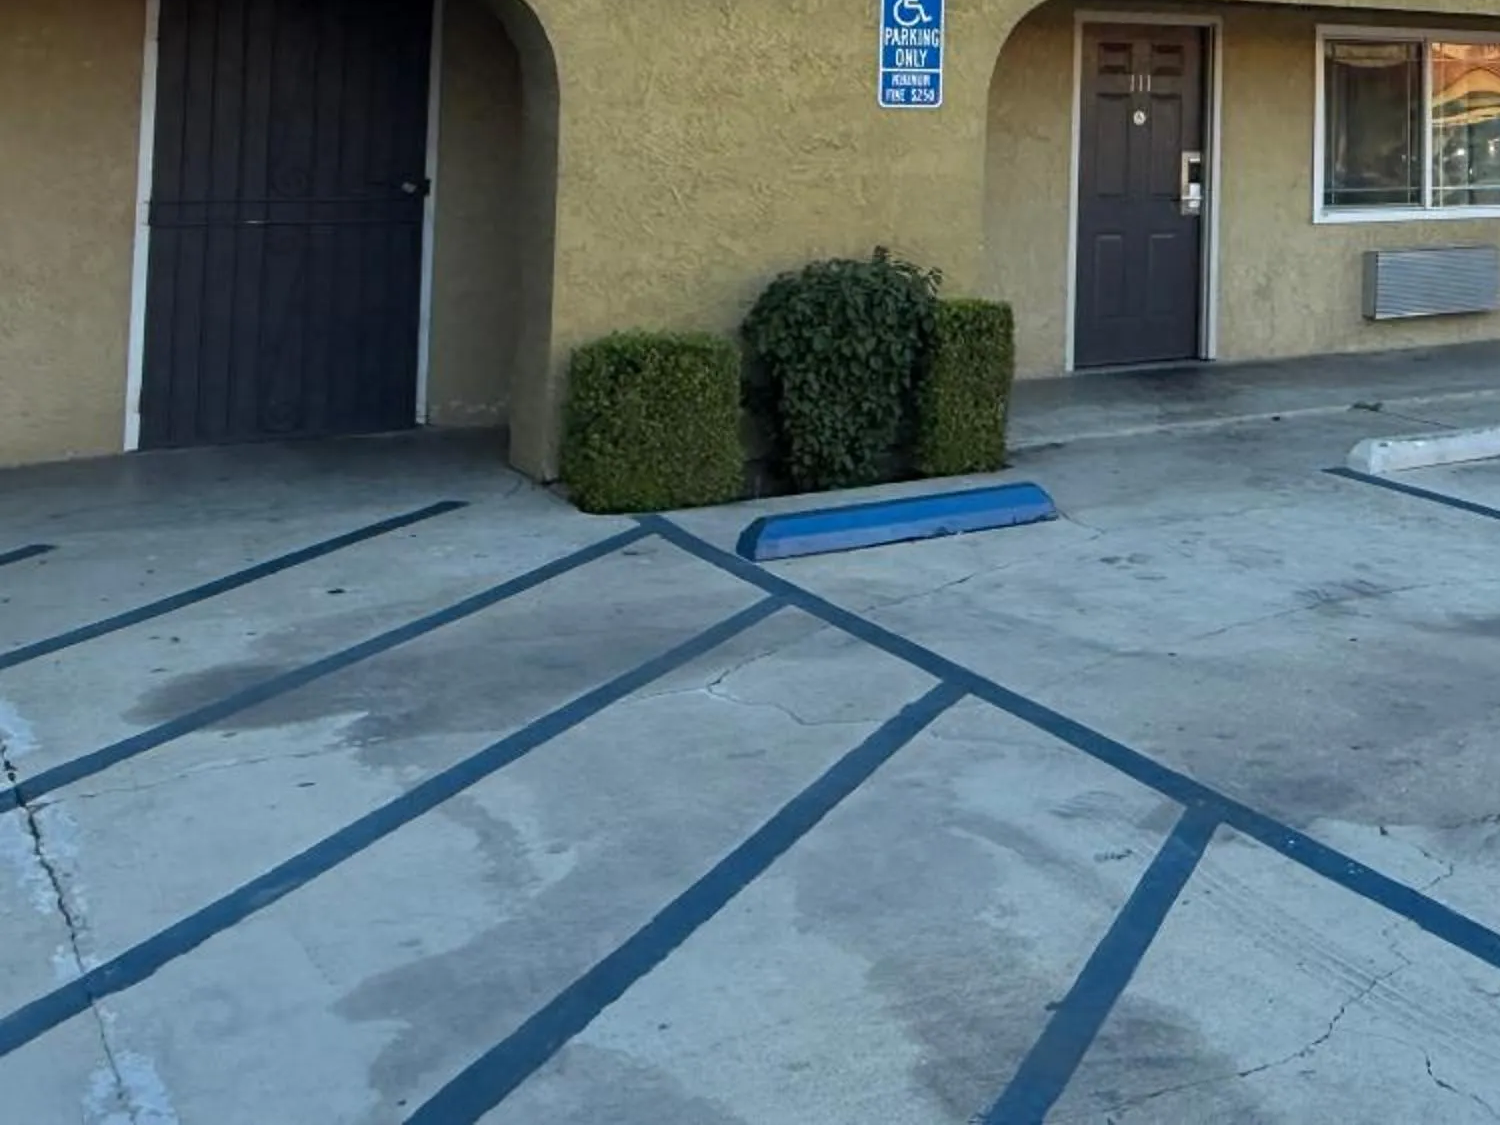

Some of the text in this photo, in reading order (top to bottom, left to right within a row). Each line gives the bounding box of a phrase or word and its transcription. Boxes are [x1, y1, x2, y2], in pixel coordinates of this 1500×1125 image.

[885, 27, 940, 47] PARKING
[895, 48, 928, 67] ONLY
[891, 74, 931, 87] MINIMUM
[1130, 74, 1151, 92] 111
[885, 88, 935, 102] FINE $250
